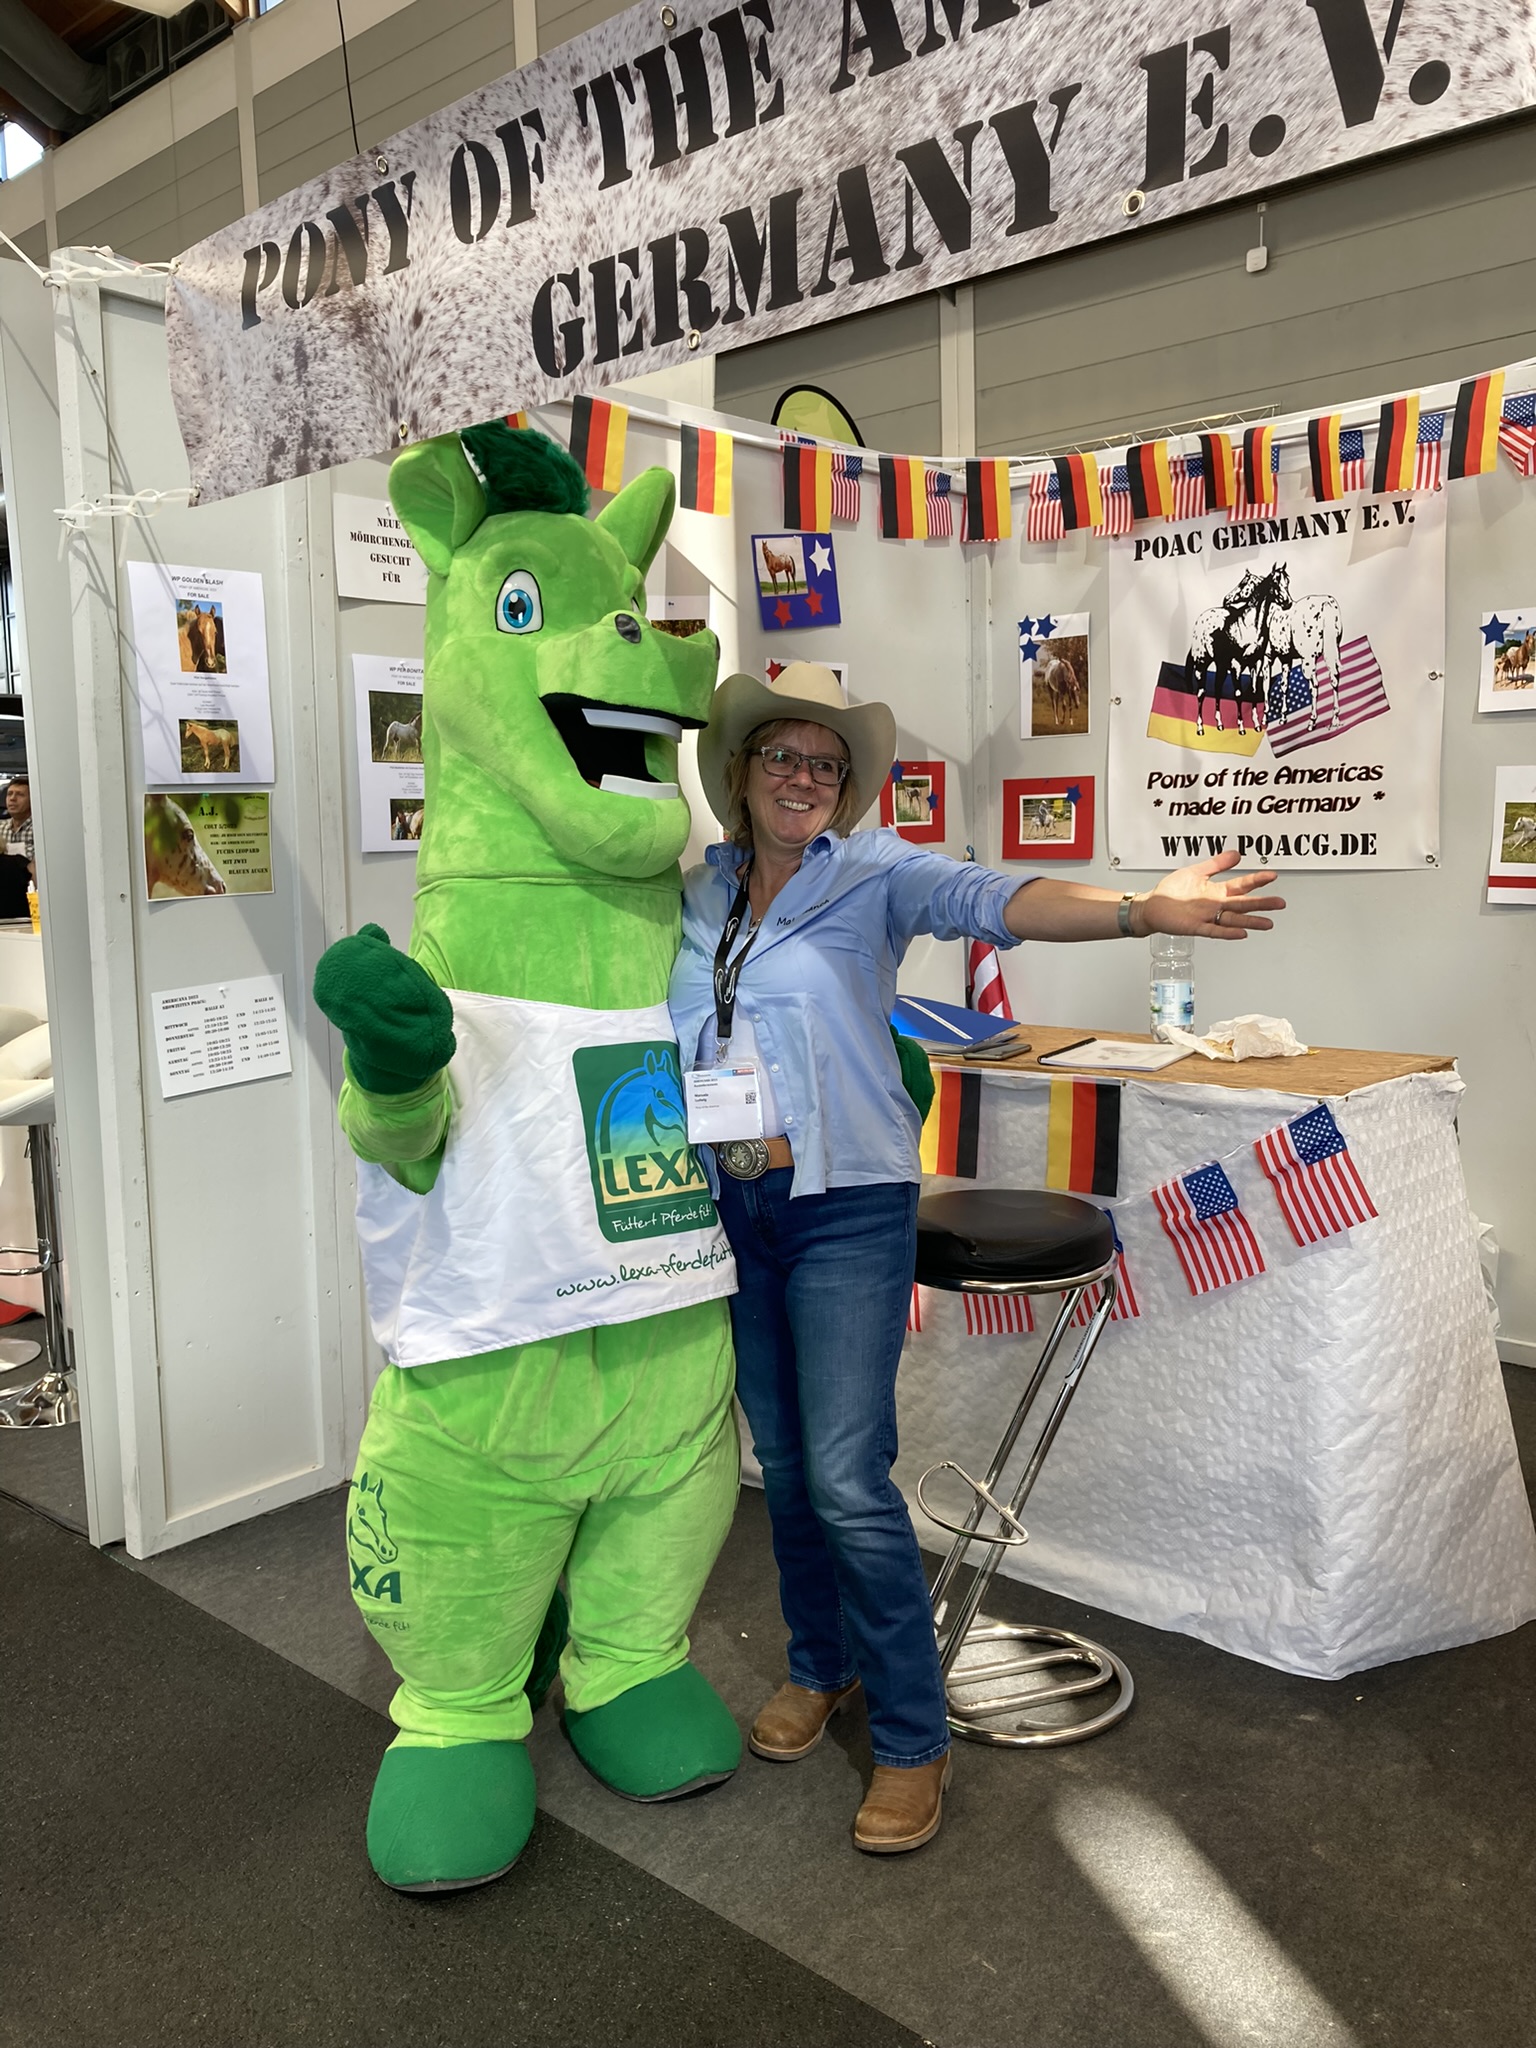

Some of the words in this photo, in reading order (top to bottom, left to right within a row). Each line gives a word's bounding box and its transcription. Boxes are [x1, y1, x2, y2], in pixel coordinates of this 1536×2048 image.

[242, 171, 416, 330] PONY
[449, 108, 546, 244] OF
[573, 0, 785, 190] THE
[532, 82, 1082, 378] GERMANY
[377, 518, 401, 529] NEUE
[350, 531, 415, 549] MÖHRCHENGE
[1134, 531, 1203, 561] POAC
[1212, 509, 1351, 551] GERMANY
[370, 553, 411, 567] GESUCHT
[182, 576, 204, 584] GOLDEN
[382, 571, 401, 583] FÜR
[1147, 771, 1199, 790] Pony
[1204, 768, 1229, 787] of
[1233, 767, 1269, 786] the
[1274, 763, 1384, 785] Americas
[199, 806, 219, 817] A.J.
[1169, 797, 1226, 817] made
[1231, 796, 1252, 815] in
[1257, 795, 1361, 815] Germany
[603, 1148, 705, 1196] LEXA
[612, 1214, 658, 1233] Füttert
